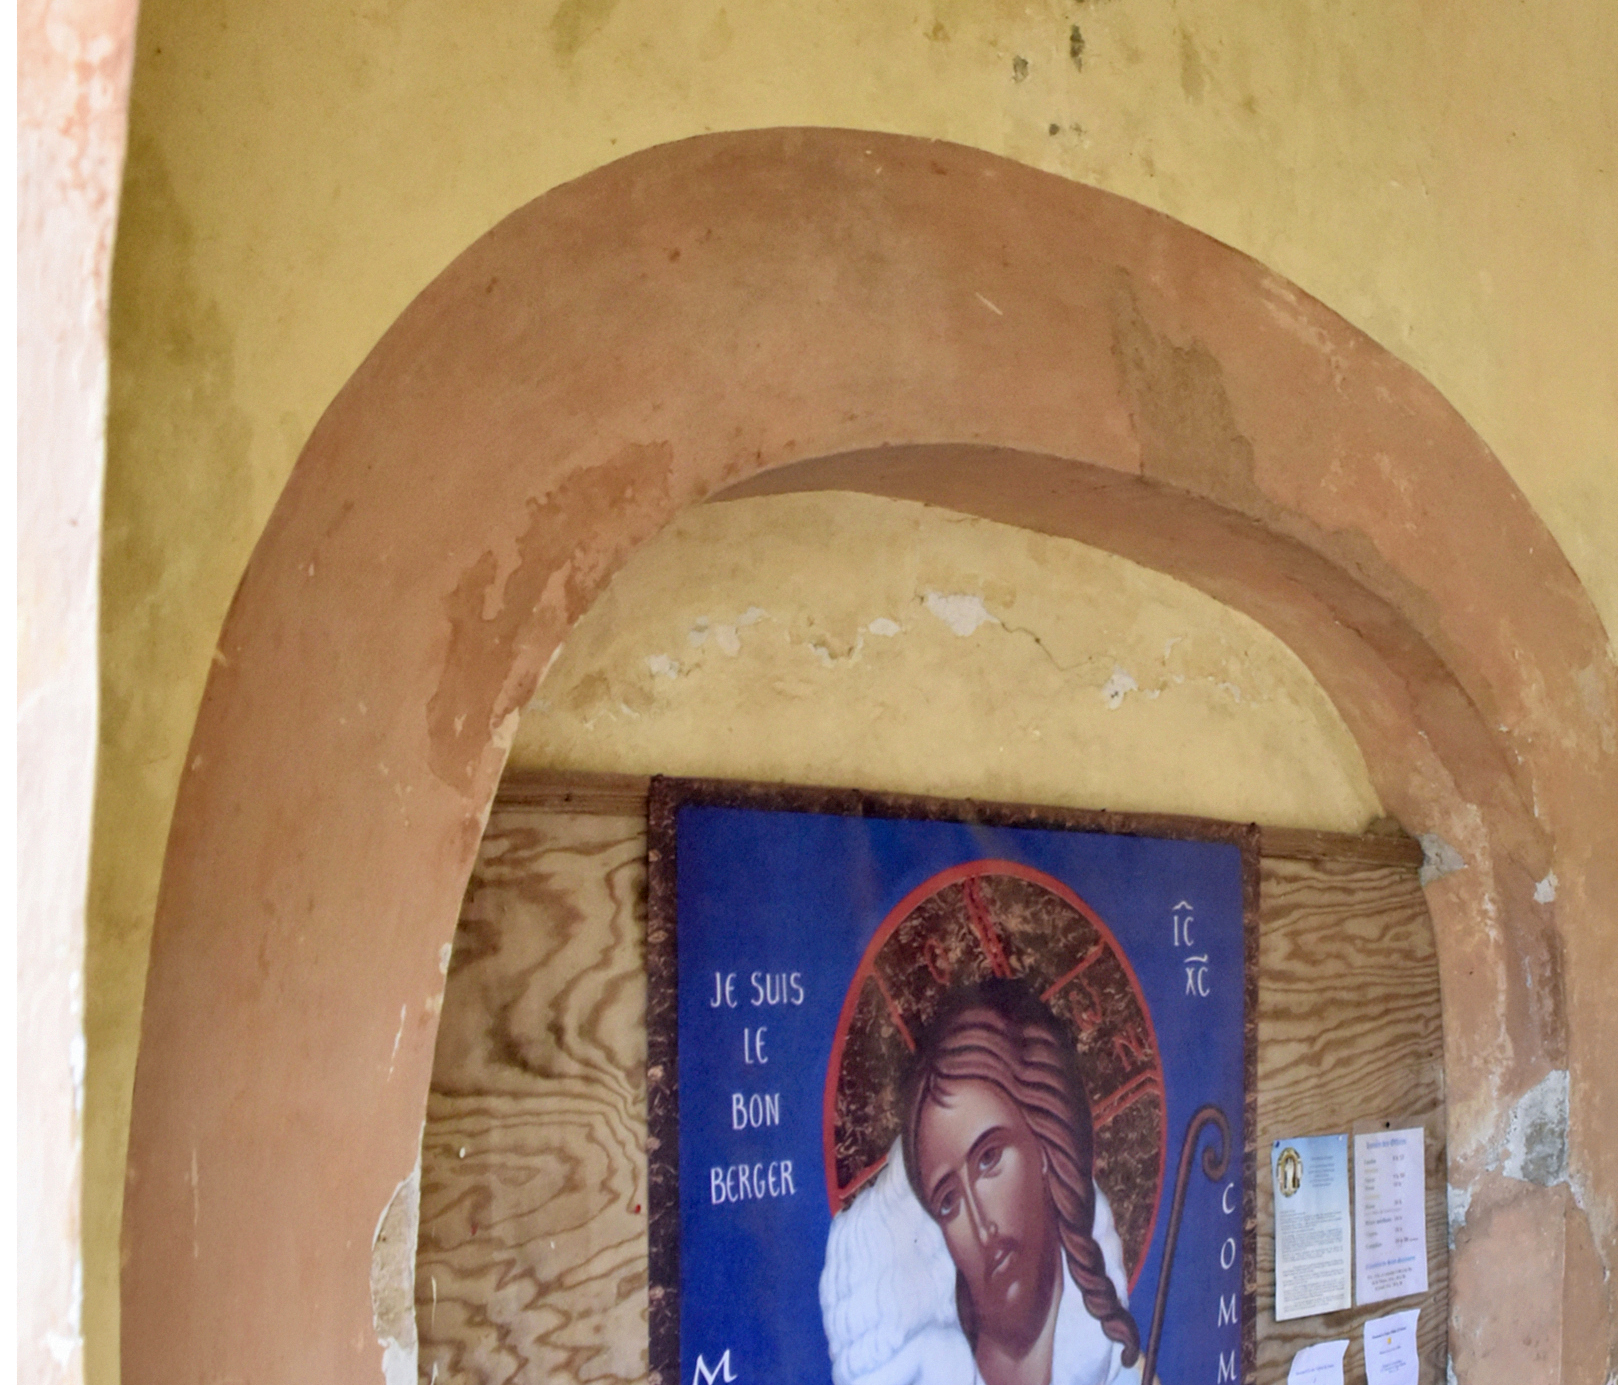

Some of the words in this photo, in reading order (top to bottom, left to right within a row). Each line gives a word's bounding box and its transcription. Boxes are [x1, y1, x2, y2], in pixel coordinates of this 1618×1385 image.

[710, 971, 738, 1008] JE
[750, 971, 805, 1007] SUIS
[743, 1026, 769, 1065] LE
[731, 1092, 781, 1131] BON
[710, 1159, 797, 1205] BERGER
